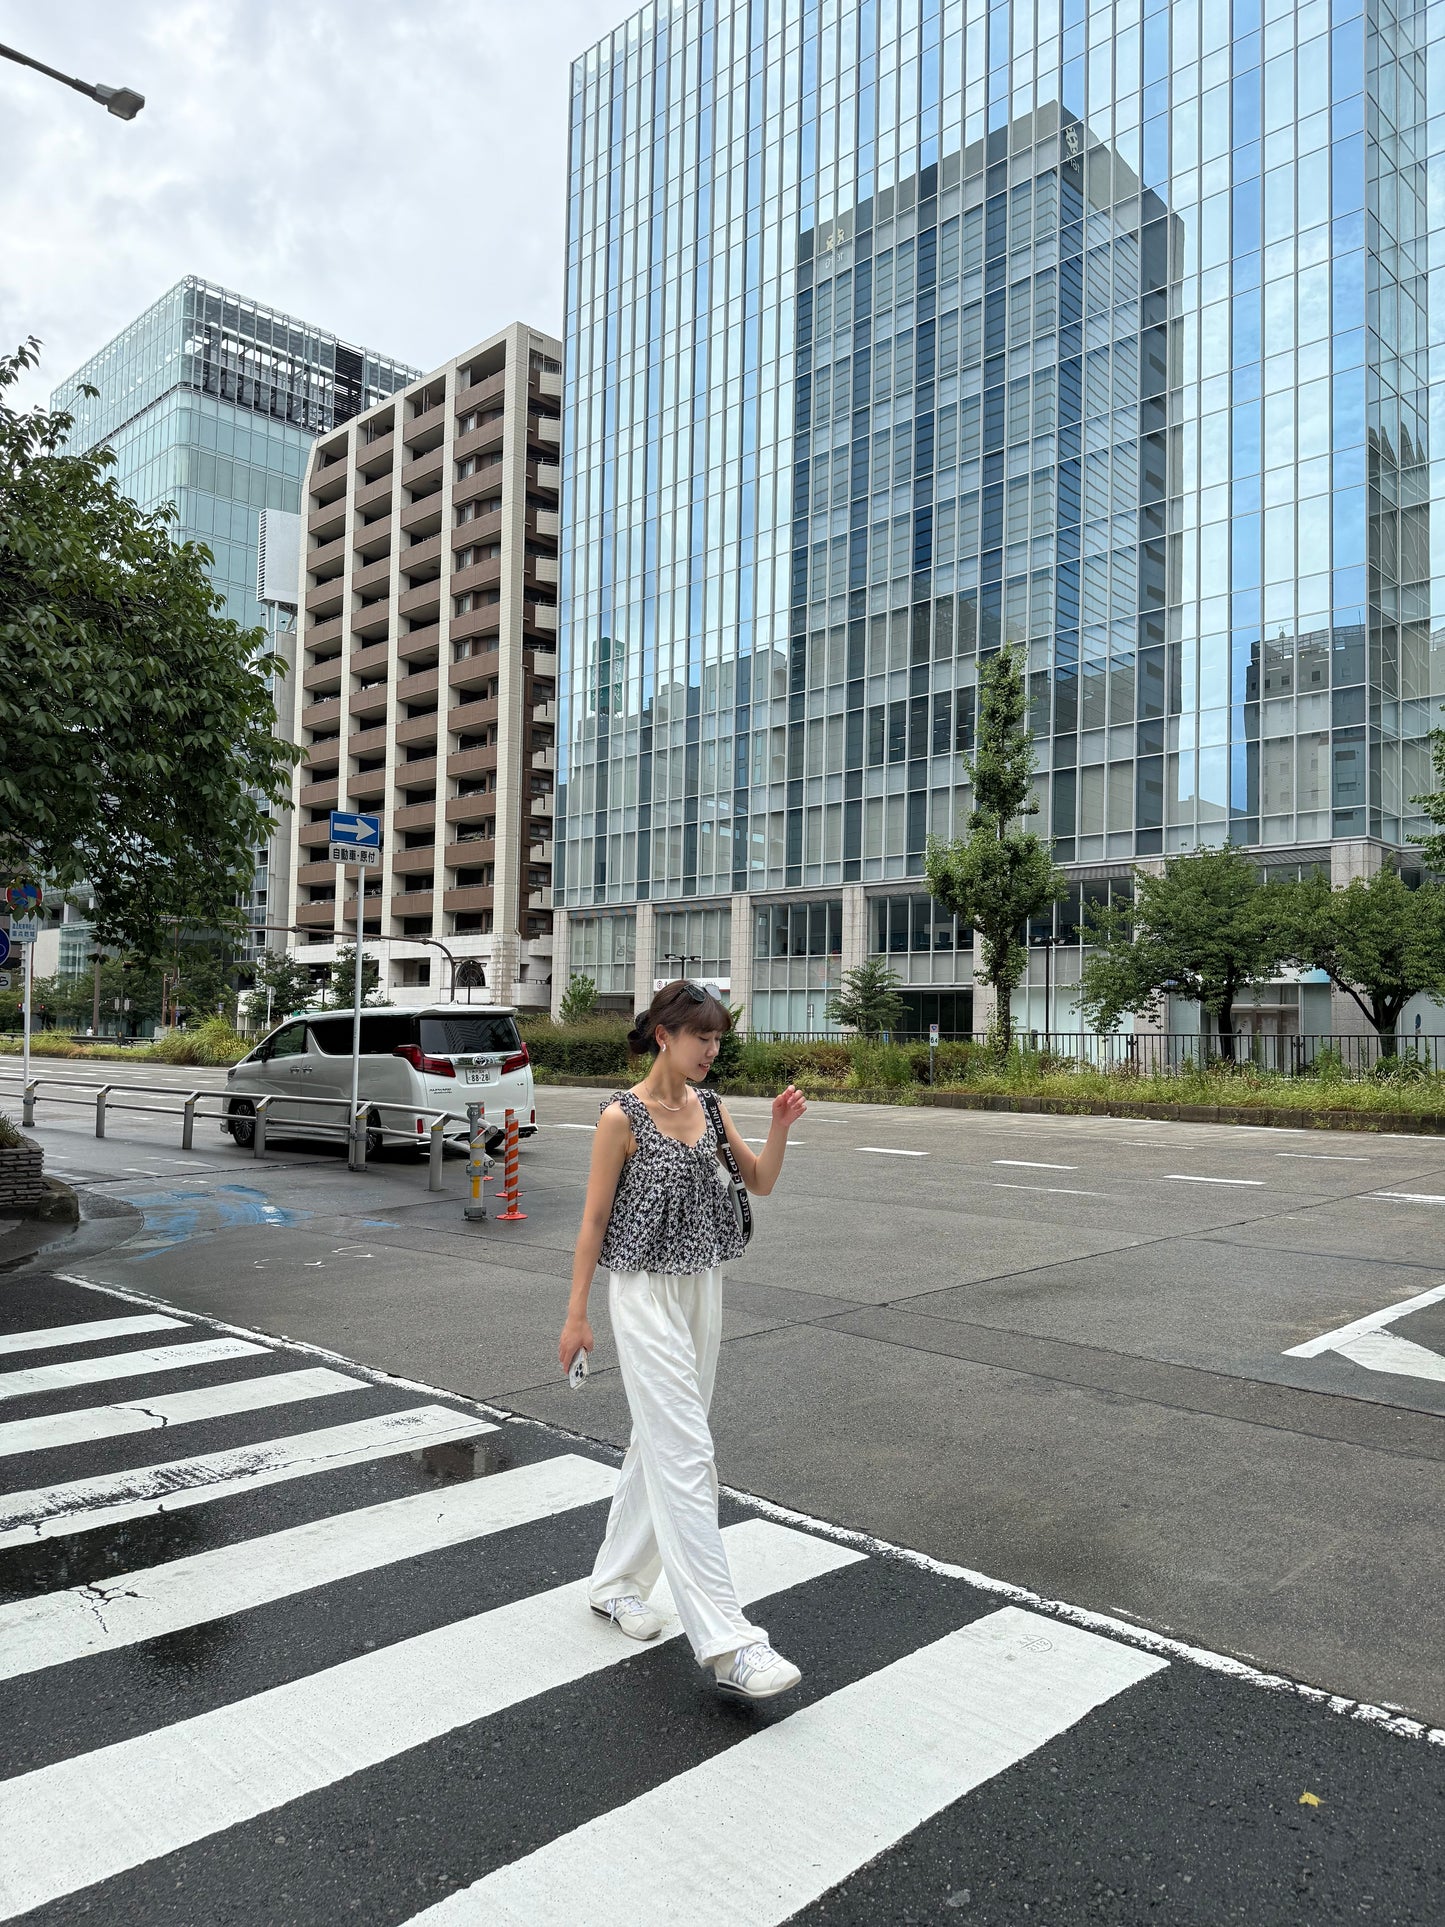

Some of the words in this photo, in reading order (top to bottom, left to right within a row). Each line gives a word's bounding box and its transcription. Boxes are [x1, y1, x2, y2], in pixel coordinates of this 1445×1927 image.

[333, 848, 375, 863] 自動車・原付
[710, 1105, 724, 1135] CELINE
[725, 1147, 738, 1172] CELIN
